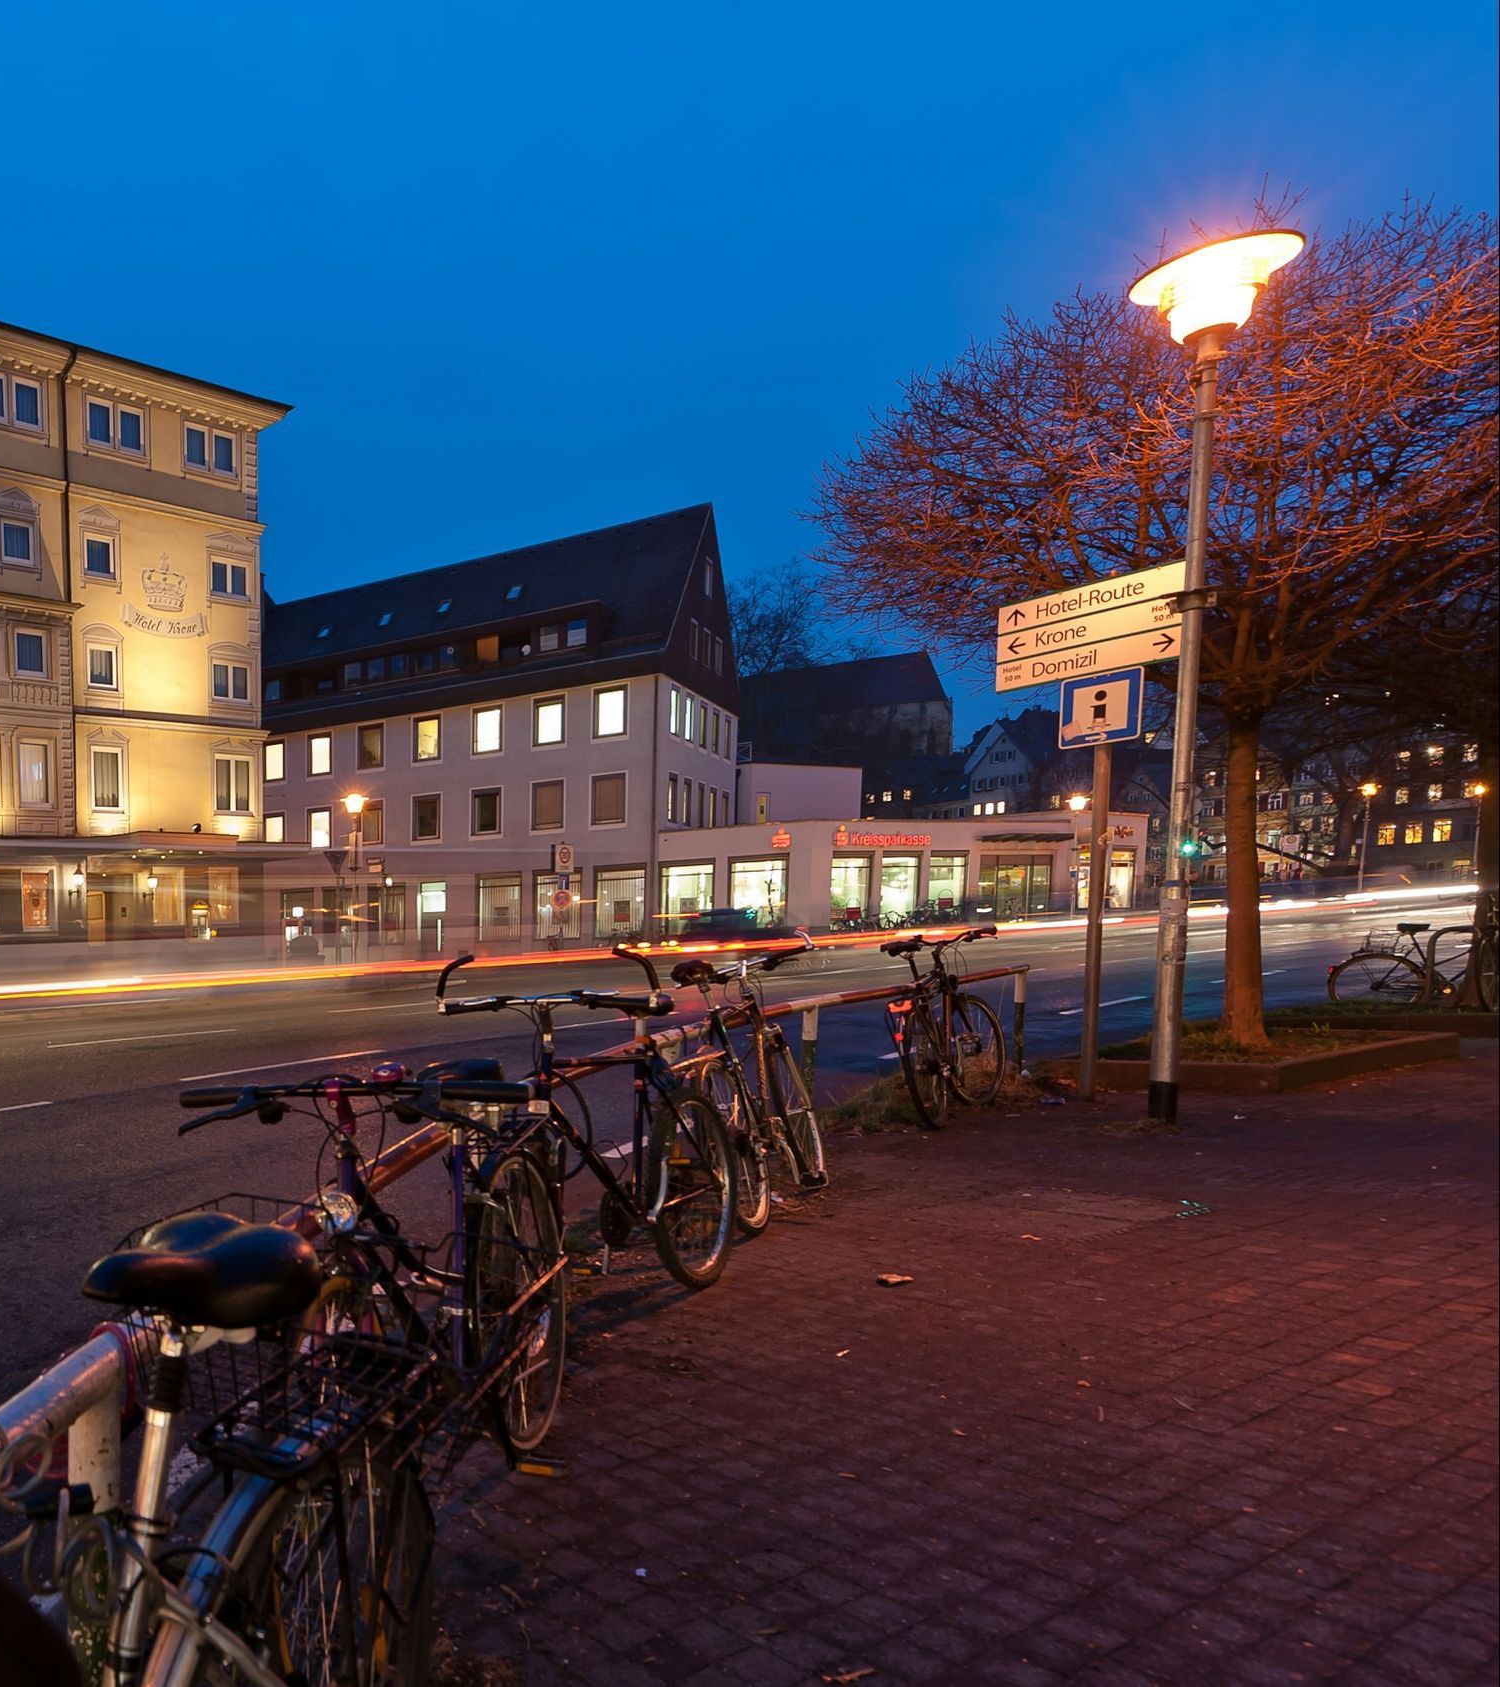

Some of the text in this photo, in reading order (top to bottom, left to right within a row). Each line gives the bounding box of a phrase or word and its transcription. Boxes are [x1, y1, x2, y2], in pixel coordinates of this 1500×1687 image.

[1036, 582, 1145, 620] Hotel-Route
[132, 612, 197, 635] Hotel Krone
[1035, 625, 1087, 648] Krone
[1002, 663, 1022, 674] Hotel
[1031, 649, 1097, 678] Domizil
[1004, 675, 1013, 683] 50
[851, 832, 931, 847] Kreissparkasse
